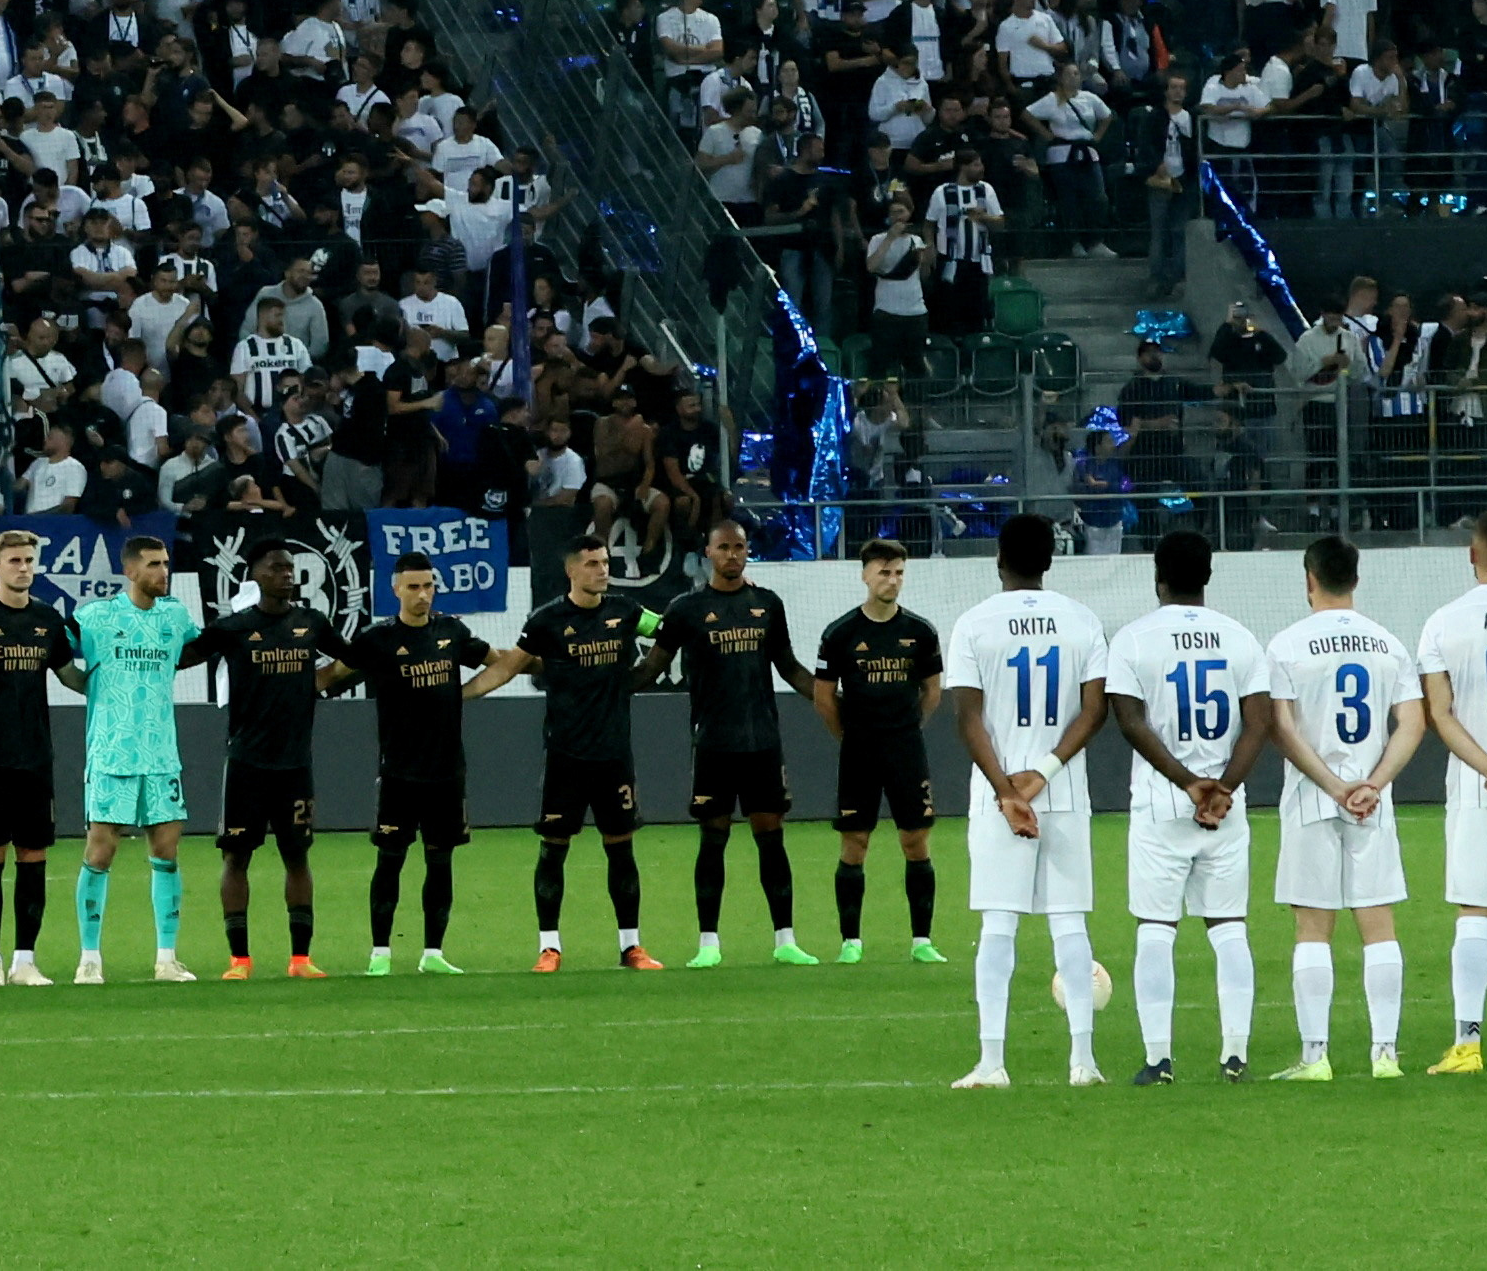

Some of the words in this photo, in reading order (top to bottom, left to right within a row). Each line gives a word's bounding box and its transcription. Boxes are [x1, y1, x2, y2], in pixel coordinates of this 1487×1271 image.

[381, 516, 491, 556] FREE
[80, 579, 123, 597] FCZ
[1008, 616, 1058, 636] OKITA
[1171, 631, 1221, 651] TOSIN
[1308, 634, 1389, 656] GUERRERO
[115, 645, 170, 661] Emirates
[251, 647, 310, 664] Emirates
[1006, 645, 1060, 727] 11
[1165, 659, 1230, 742] 15
[1335, 663, 1372, 745] 3
